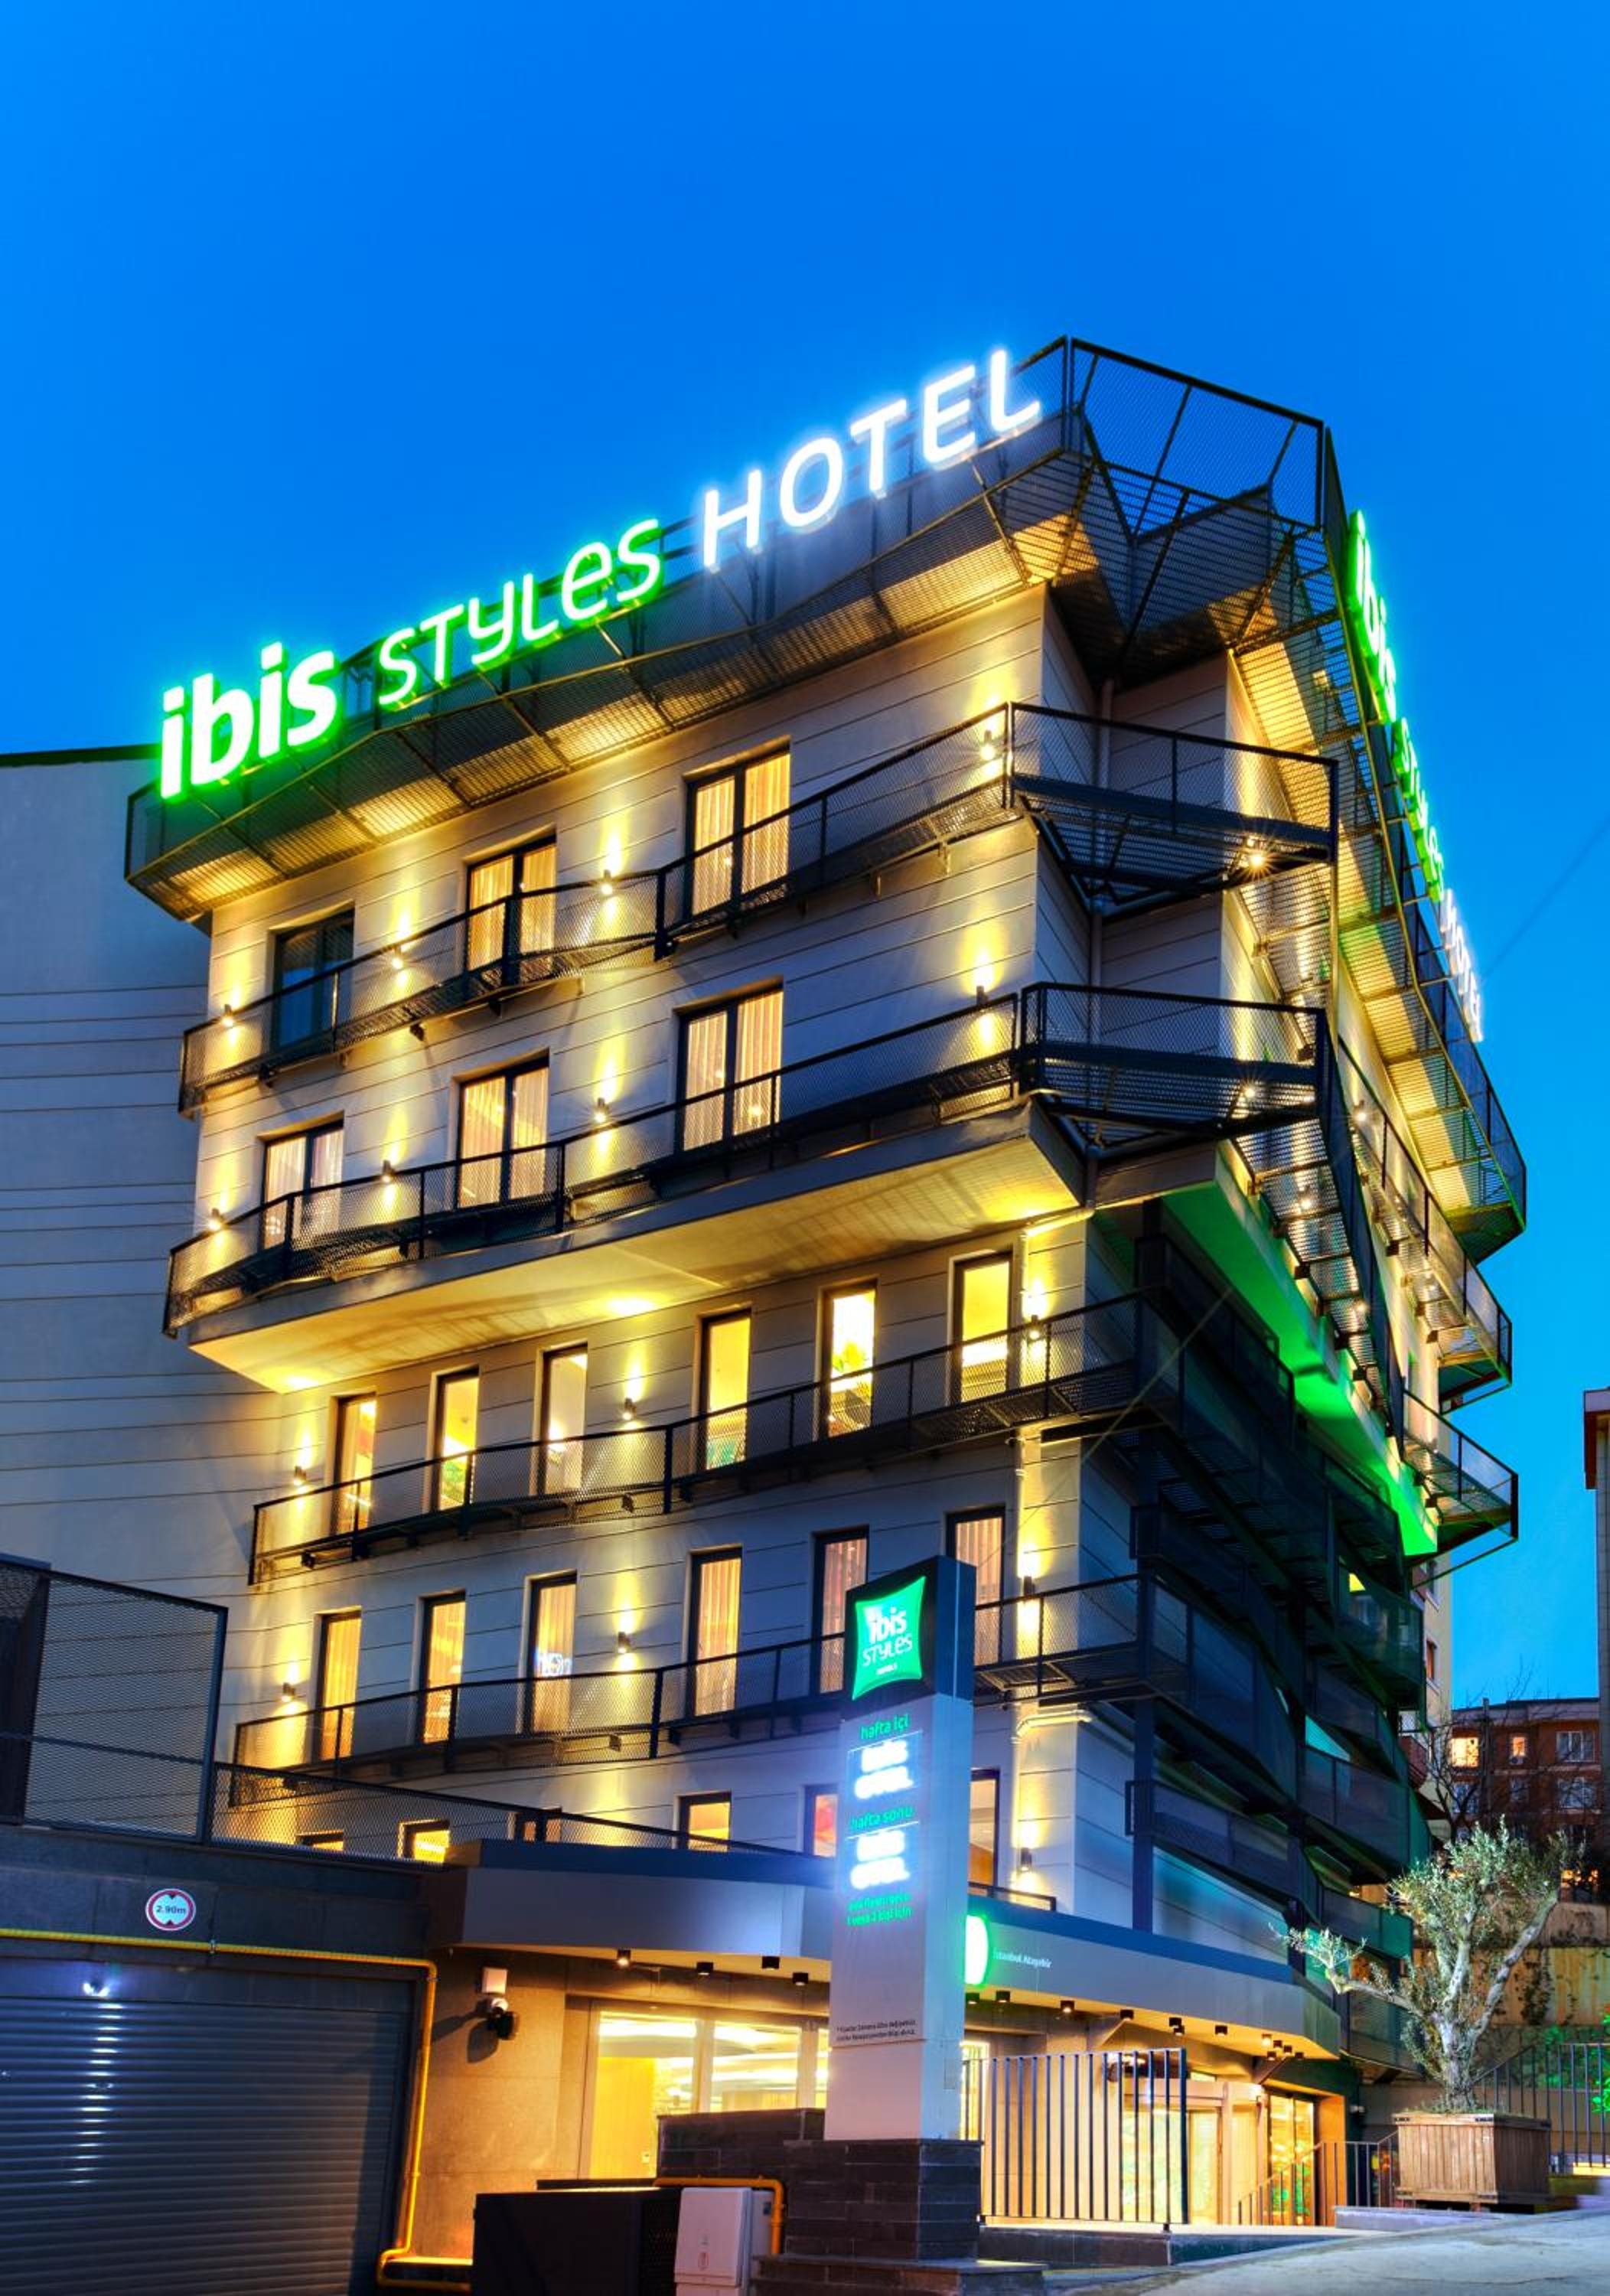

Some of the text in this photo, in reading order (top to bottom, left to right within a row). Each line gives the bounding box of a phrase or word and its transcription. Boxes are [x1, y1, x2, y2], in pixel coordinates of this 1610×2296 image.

[159, 643, 337, 799] ibis
[700, 347, 1043, 570] HOTEL
[869, 1606, 907, 1645] ibis
[860, 1720, 891, 1740] hafta
